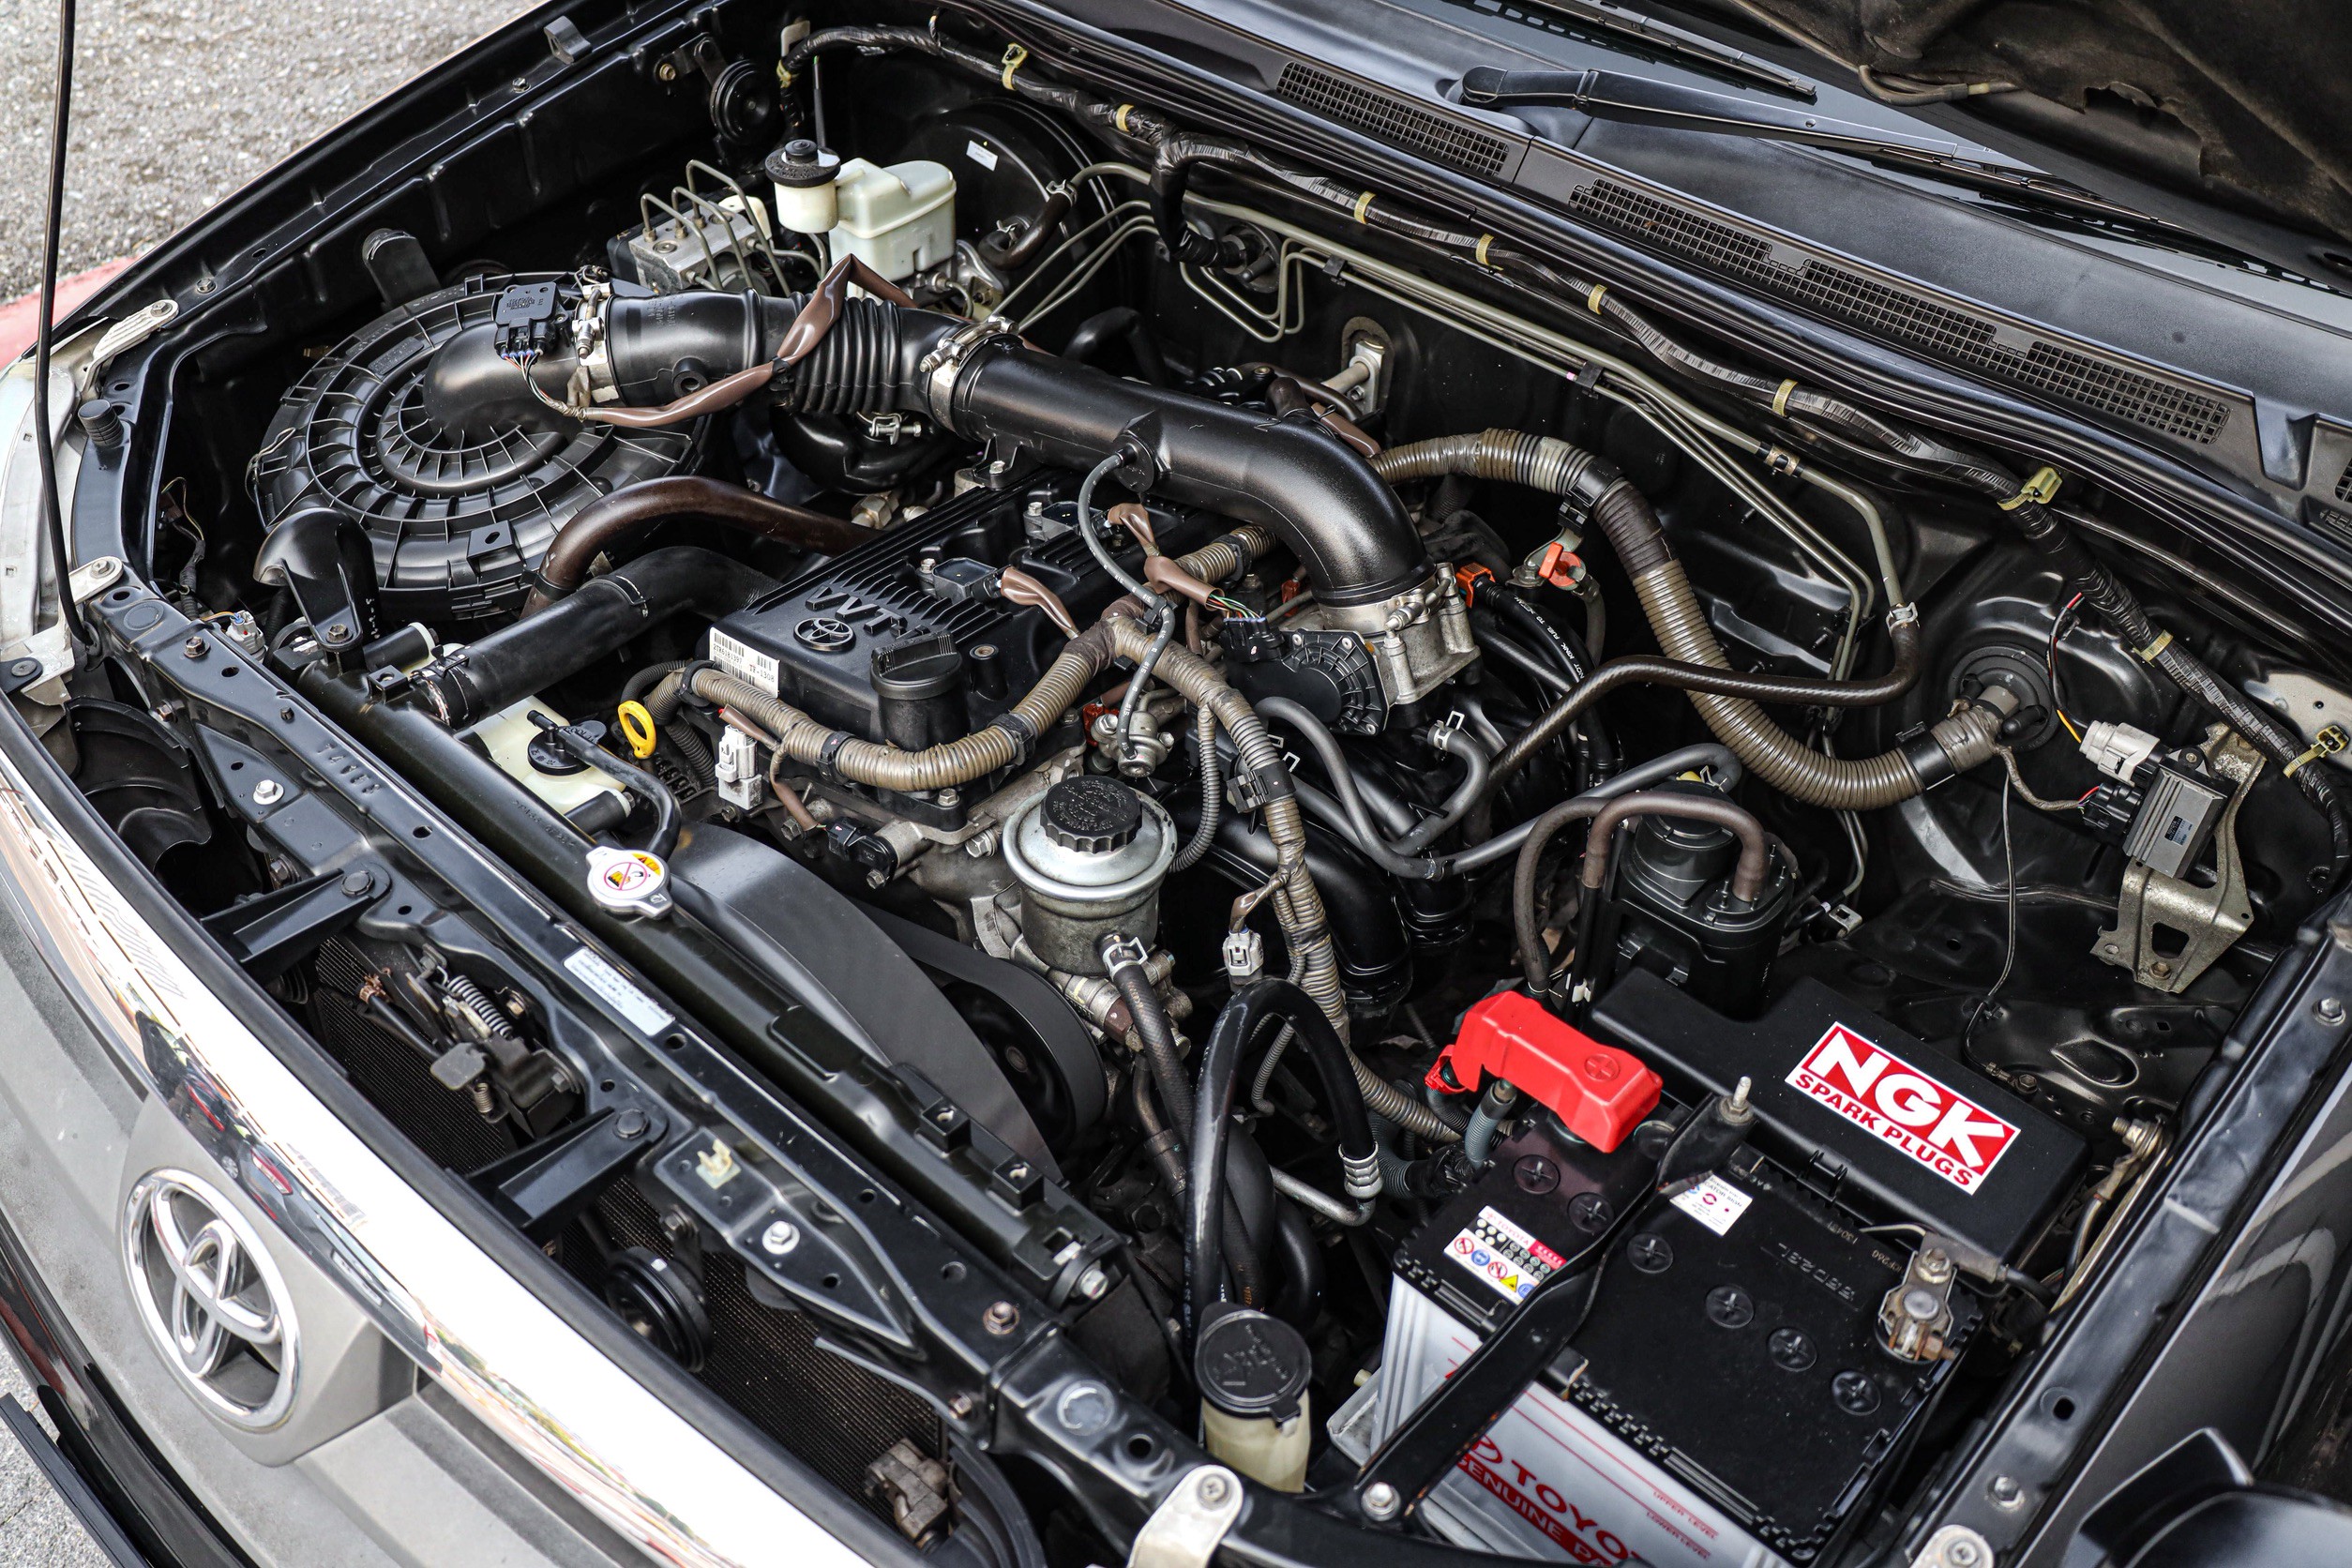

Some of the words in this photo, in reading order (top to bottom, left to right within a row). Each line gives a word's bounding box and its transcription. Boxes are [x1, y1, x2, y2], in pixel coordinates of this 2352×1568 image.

[1795, 1073, 1881, 1130] SPARK
[1882, 1125, 1973, 1186] PLUGS
[1807, 1031, 2005, 1168] NGK
[1498, 1220, 1530, 1245] TOYOTA
[1511, 1459, 1639, 1560] TOYO
[1646, 1511, 1680, 1538] LOWER
[1681, 1536, 1710, 1560] LEVEL
[1652, 1490, 1685, 1516] UPPER
[1688, 1515, 1718, 1540] LEVEL
